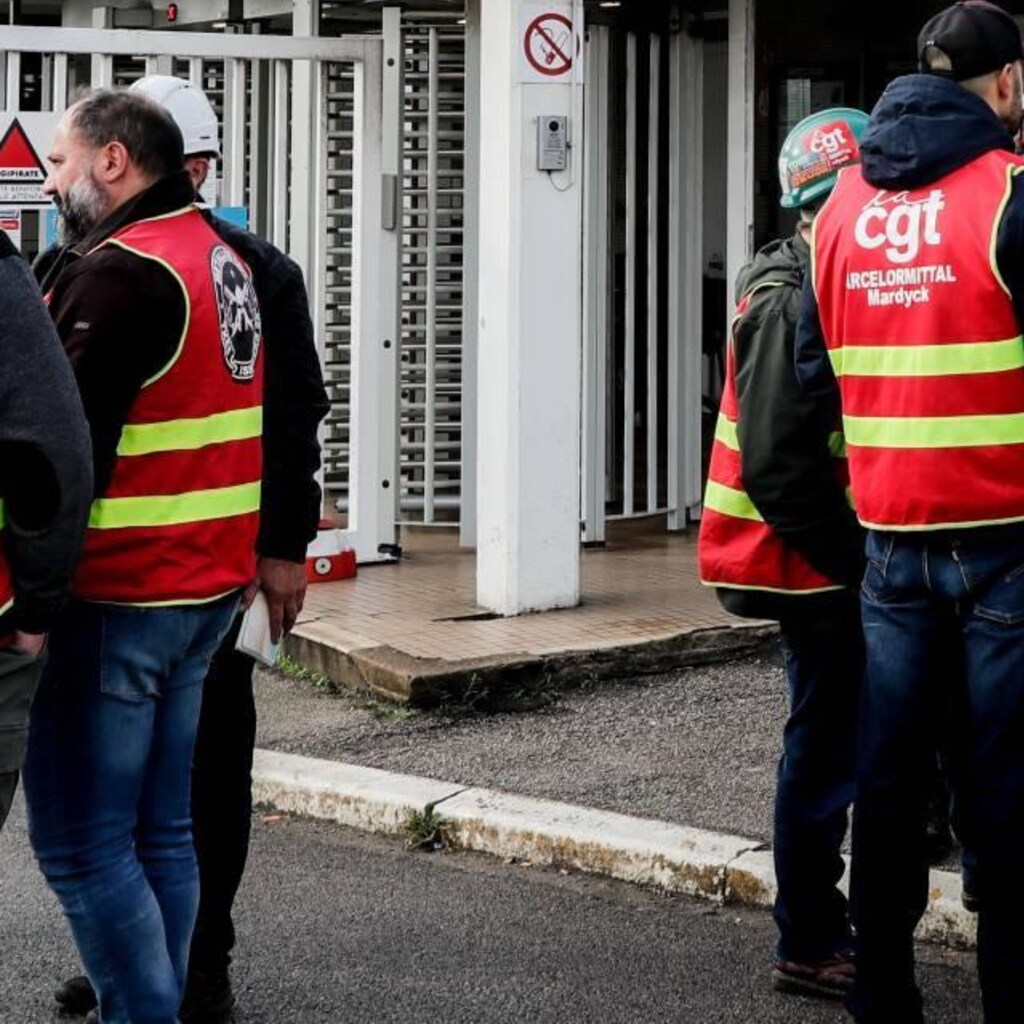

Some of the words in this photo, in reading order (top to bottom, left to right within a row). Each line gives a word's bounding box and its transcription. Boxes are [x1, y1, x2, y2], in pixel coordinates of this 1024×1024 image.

[810, 128, 847, 154] cgt
[854, 190, 945, 263] cgt
[868, 288, 929, 307] Mardyck
